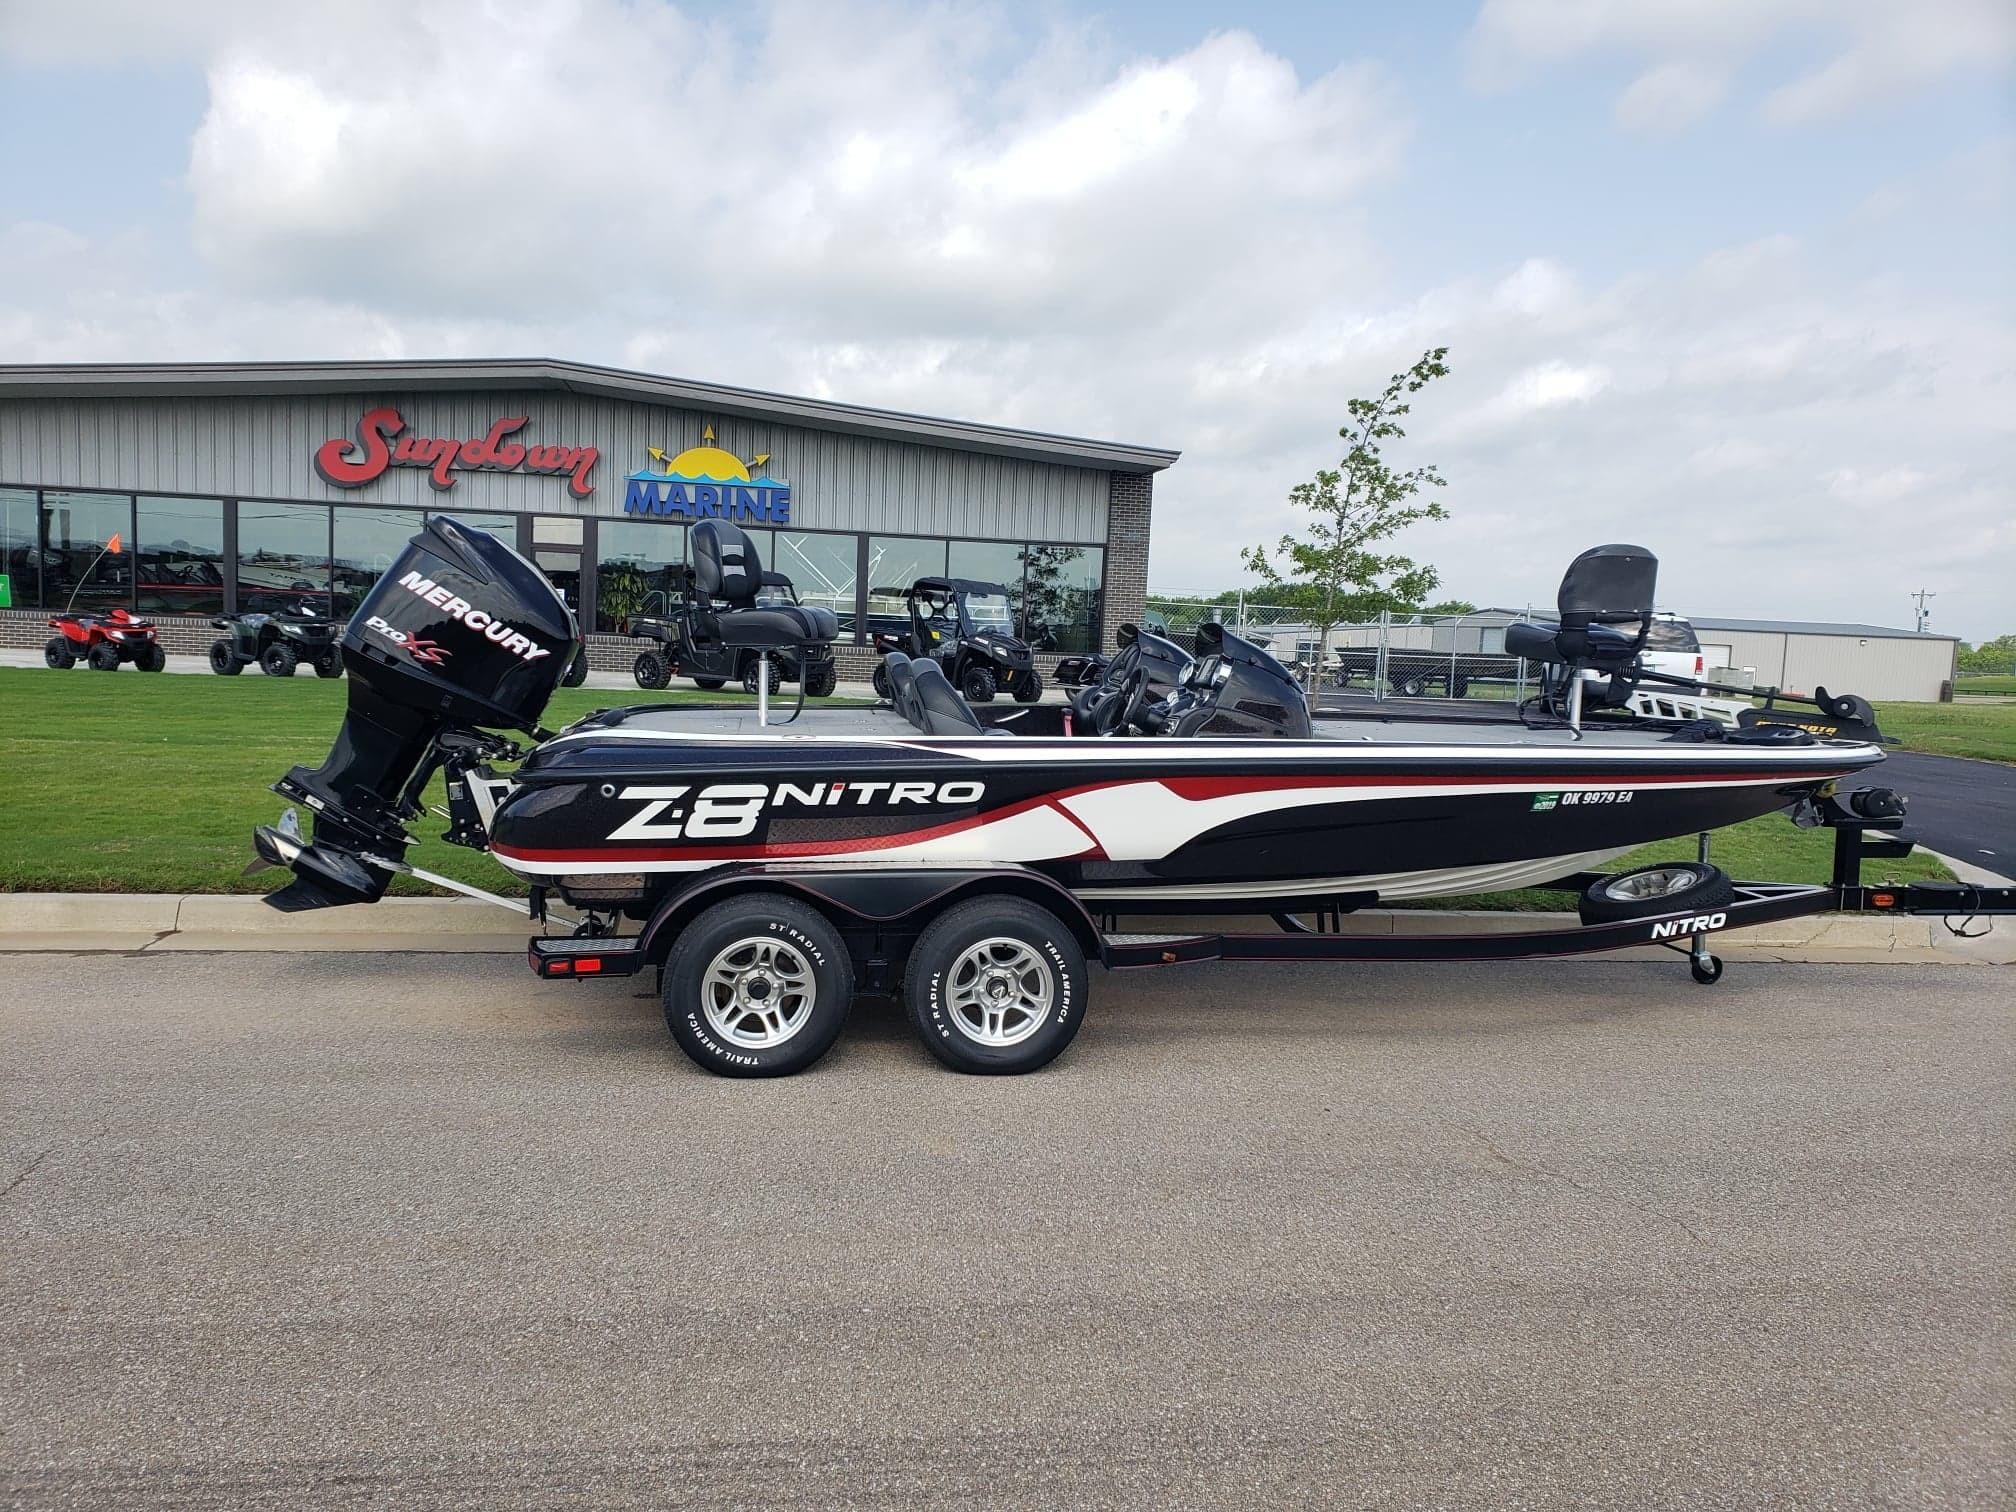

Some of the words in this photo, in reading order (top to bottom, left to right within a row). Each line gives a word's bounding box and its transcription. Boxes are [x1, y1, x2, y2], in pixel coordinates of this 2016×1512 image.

[313, 407, 600, 499] Sundown
[623, 481, 792, 522] MARINE
[365, 616, 407, 642] Pro
[398, 571, 551, 661] MERCURY
[1561, 792, 1582, 805] OK
[1582, 791, 1616, 804] 9979
[1615, 791, 1633, 803] EA
[769, 923, 786, 932] ST
[789, 929, 826, 967] RADIAL
[930, 971, 941, 1019] RADIAL
[1045, 941, 1067, 971] TRAIL
[1057, 973, 1071, 1024] AMERICA
[687, 1012, 723, 1055] AMERICA
[938, 1023, 949, 1038] ST
[725, 1053, 760, 1065] TRAIL
